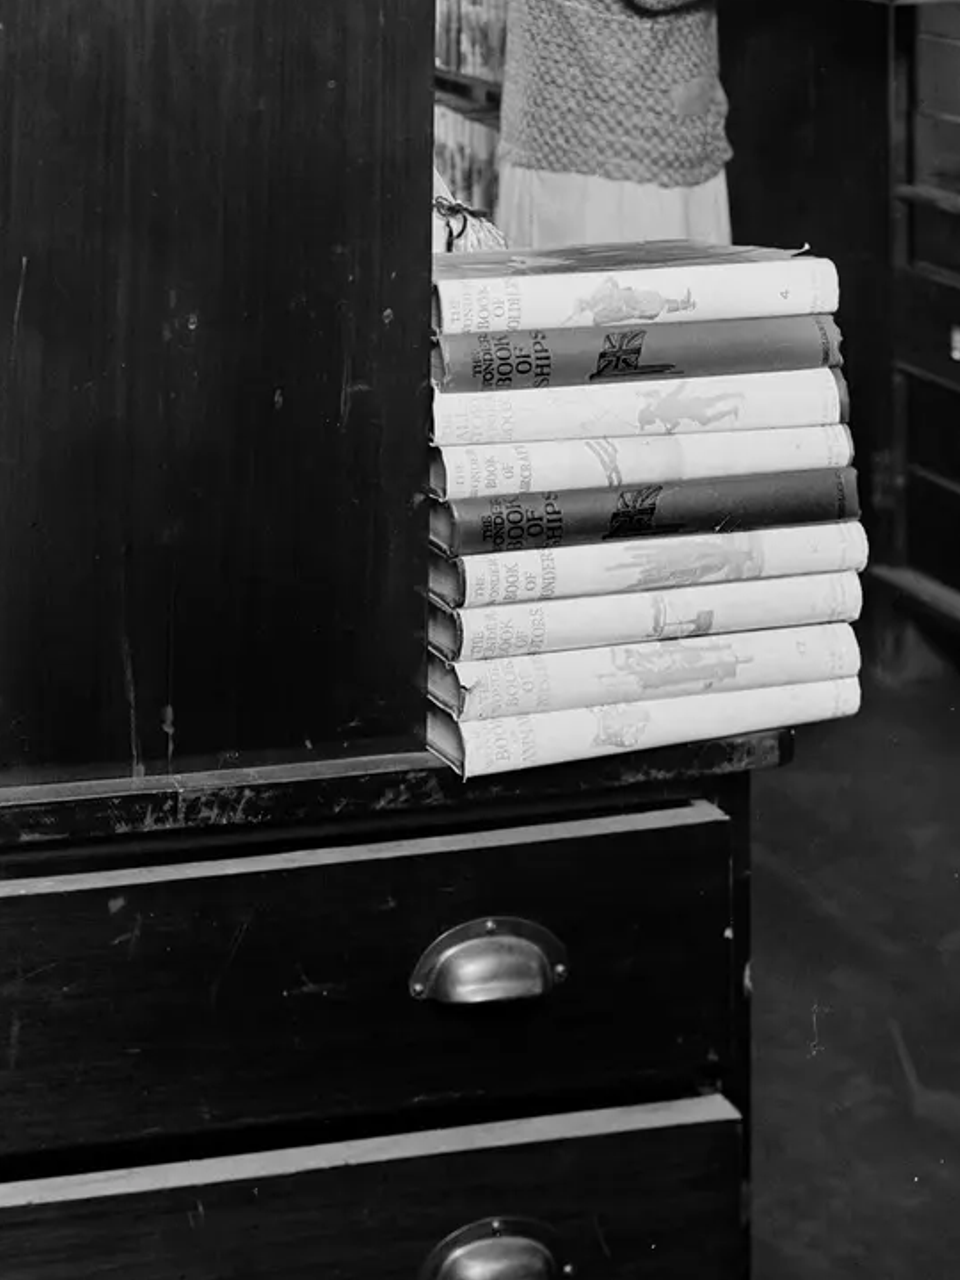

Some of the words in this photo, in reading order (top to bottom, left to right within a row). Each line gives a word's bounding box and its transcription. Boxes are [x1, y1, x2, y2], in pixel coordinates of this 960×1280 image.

[471, 350, 482, 378] THE
[491, 333, 513, 389] BOOK
[514, 345, 532, 375] OF
[529, 330, 551, 389] SHIPS
[484, 456, 498, 489] BOOK
[502, 462, 514, 480] OF
[482, 515, 492, 541] THE
[506, 495, 525, 550] BOOK
[526, 508, 544, 538] OF
[541, 491, 563, 547] SHIPS
[502, 562, 519, 601] BOOK
[523, 570, 537, 591] OF
